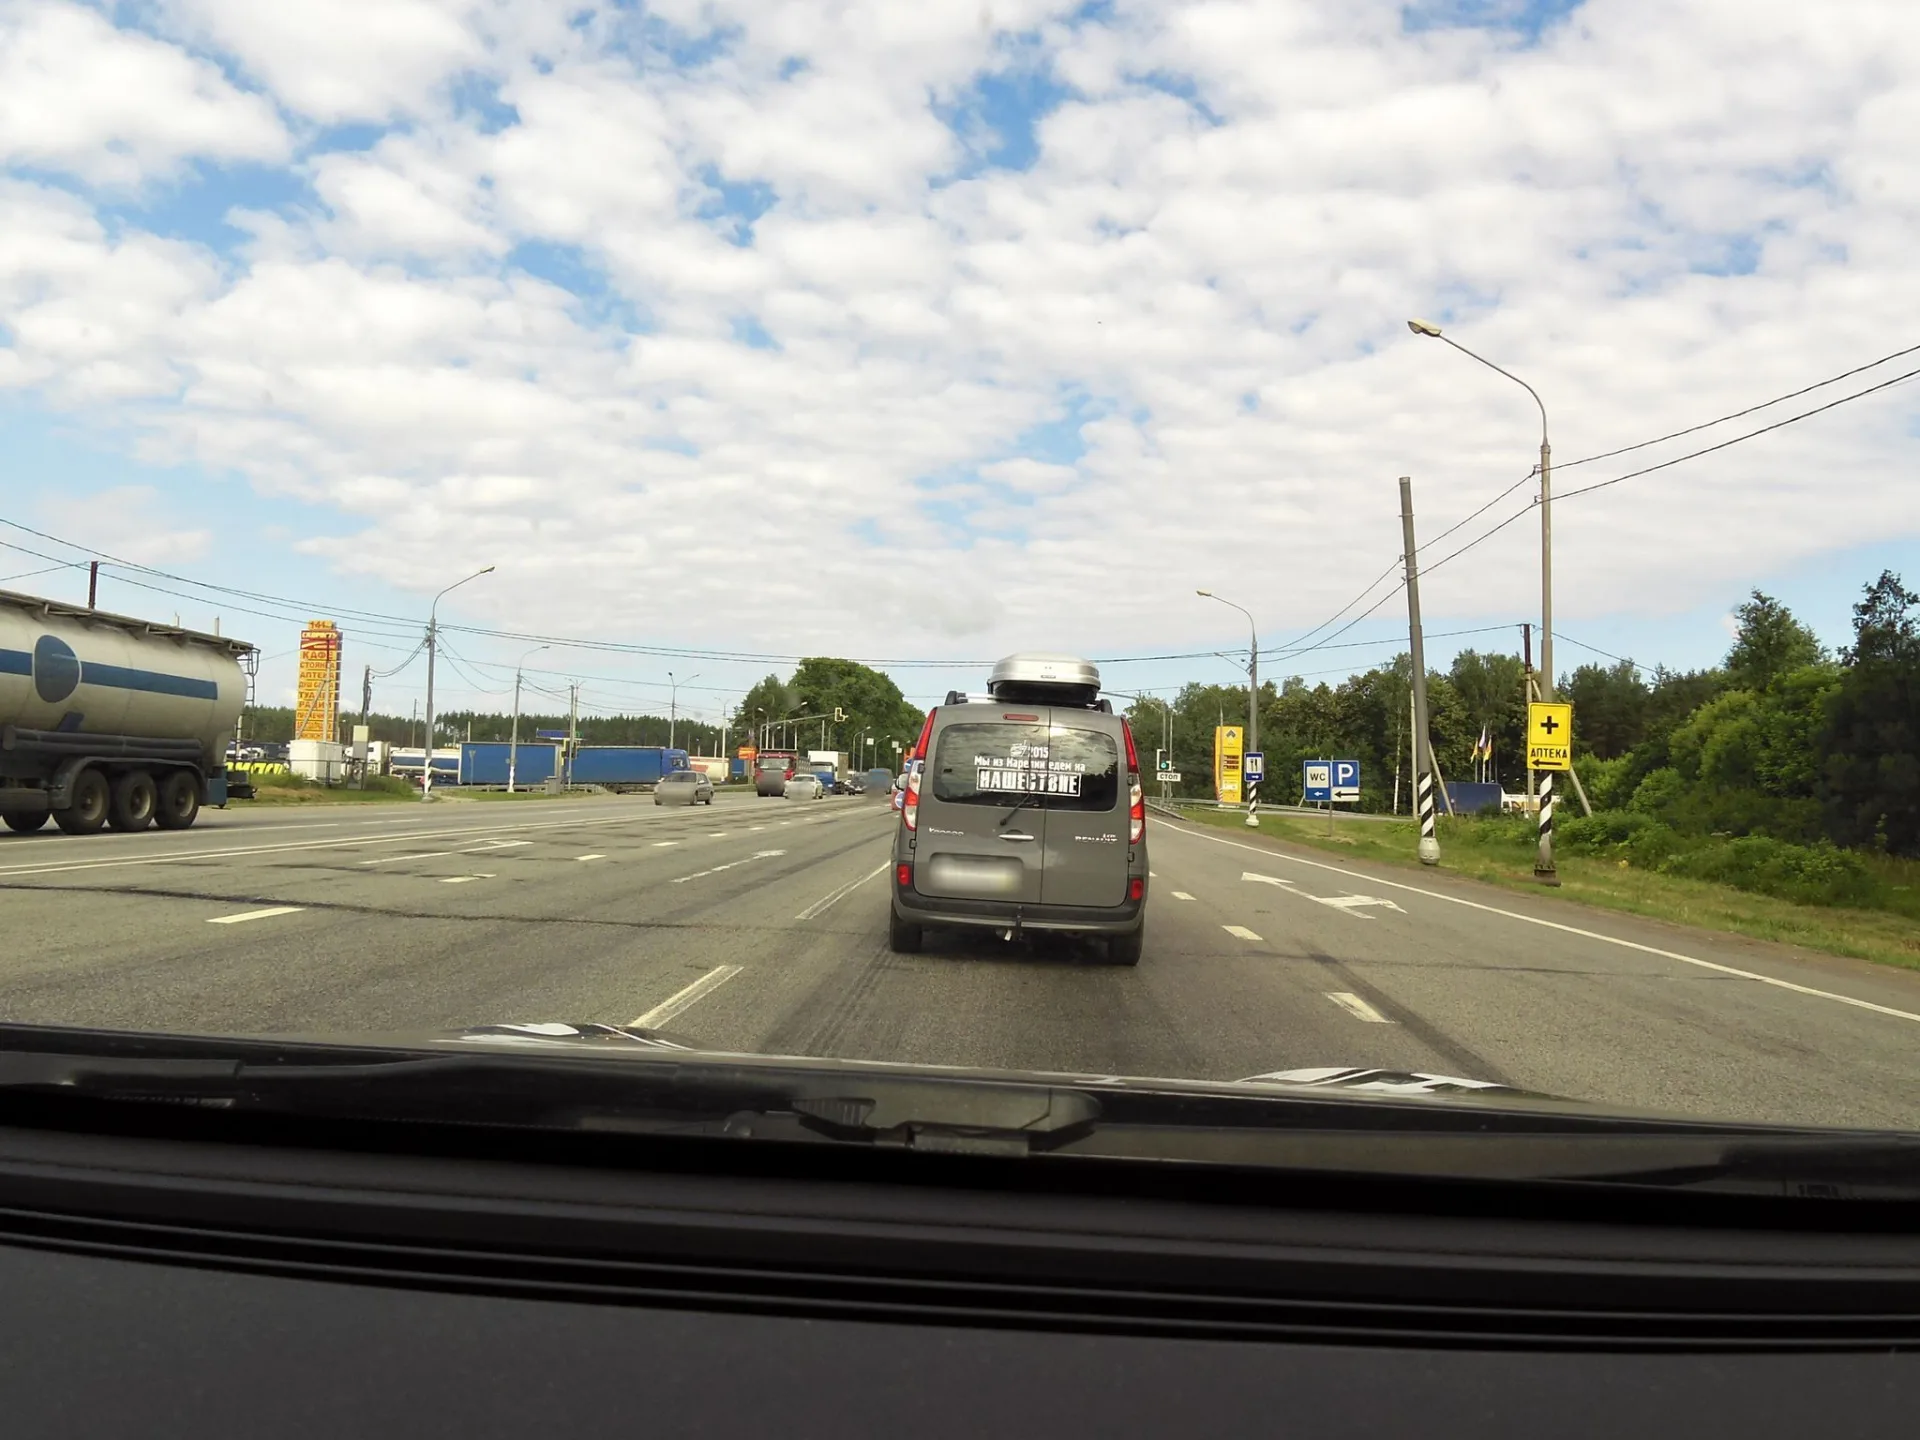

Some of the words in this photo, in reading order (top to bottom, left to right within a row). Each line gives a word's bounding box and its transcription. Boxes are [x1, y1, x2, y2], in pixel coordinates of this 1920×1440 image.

[302, 651, 334, 660] КАФЕ
[299, 691, 334, 699] ТУАЕТ
[1530, 747, 1568, 759] АПТЕКА
[974, 755, 990, 766] Мы
[992, 758, 1004, 767] из
[1048, 761, 1072, 772] едем
[1074, 762, 1086, 772] на
[1310, 773, 1326, 781] WC
[1338, 763, 1354, 785] P
[979, 770, 1078, 794] НАШЕСТВИЕ
